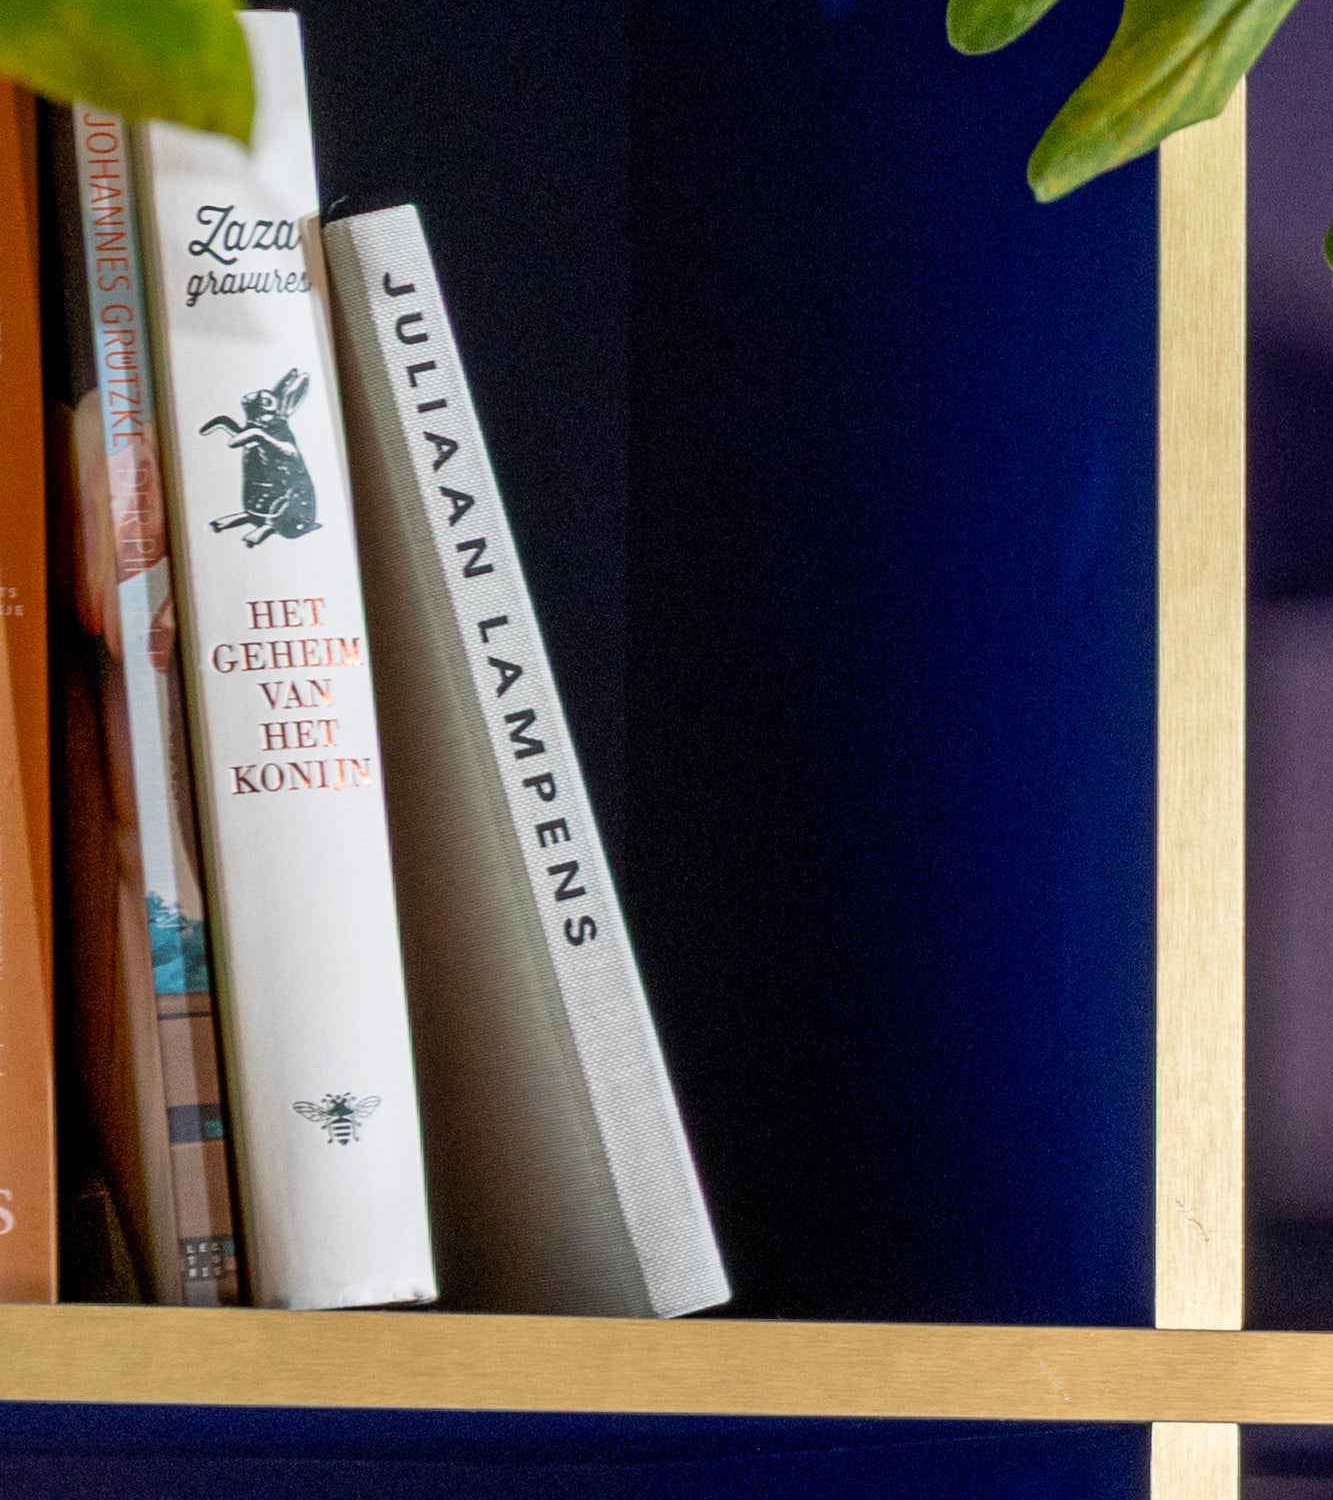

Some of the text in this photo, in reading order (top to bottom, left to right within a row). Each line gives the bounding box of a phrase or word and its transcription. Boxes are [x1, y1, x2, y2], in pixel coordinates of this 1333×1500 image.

[83, 112, 132, 294] JOHANNES
[188, 204, 301, 265] Zaza
[185, 269, 312, 307] gravures
[246, 597, 326, 630] HET
[381, 272, 597, 949] JULIAAN LAMPENS
[211, 637, 364, 675] GEHEIM
[256, 678, 334, 710] VAN
[259, 718, 340, 751] HET
[228, 757, 373, 796] KONIJN
